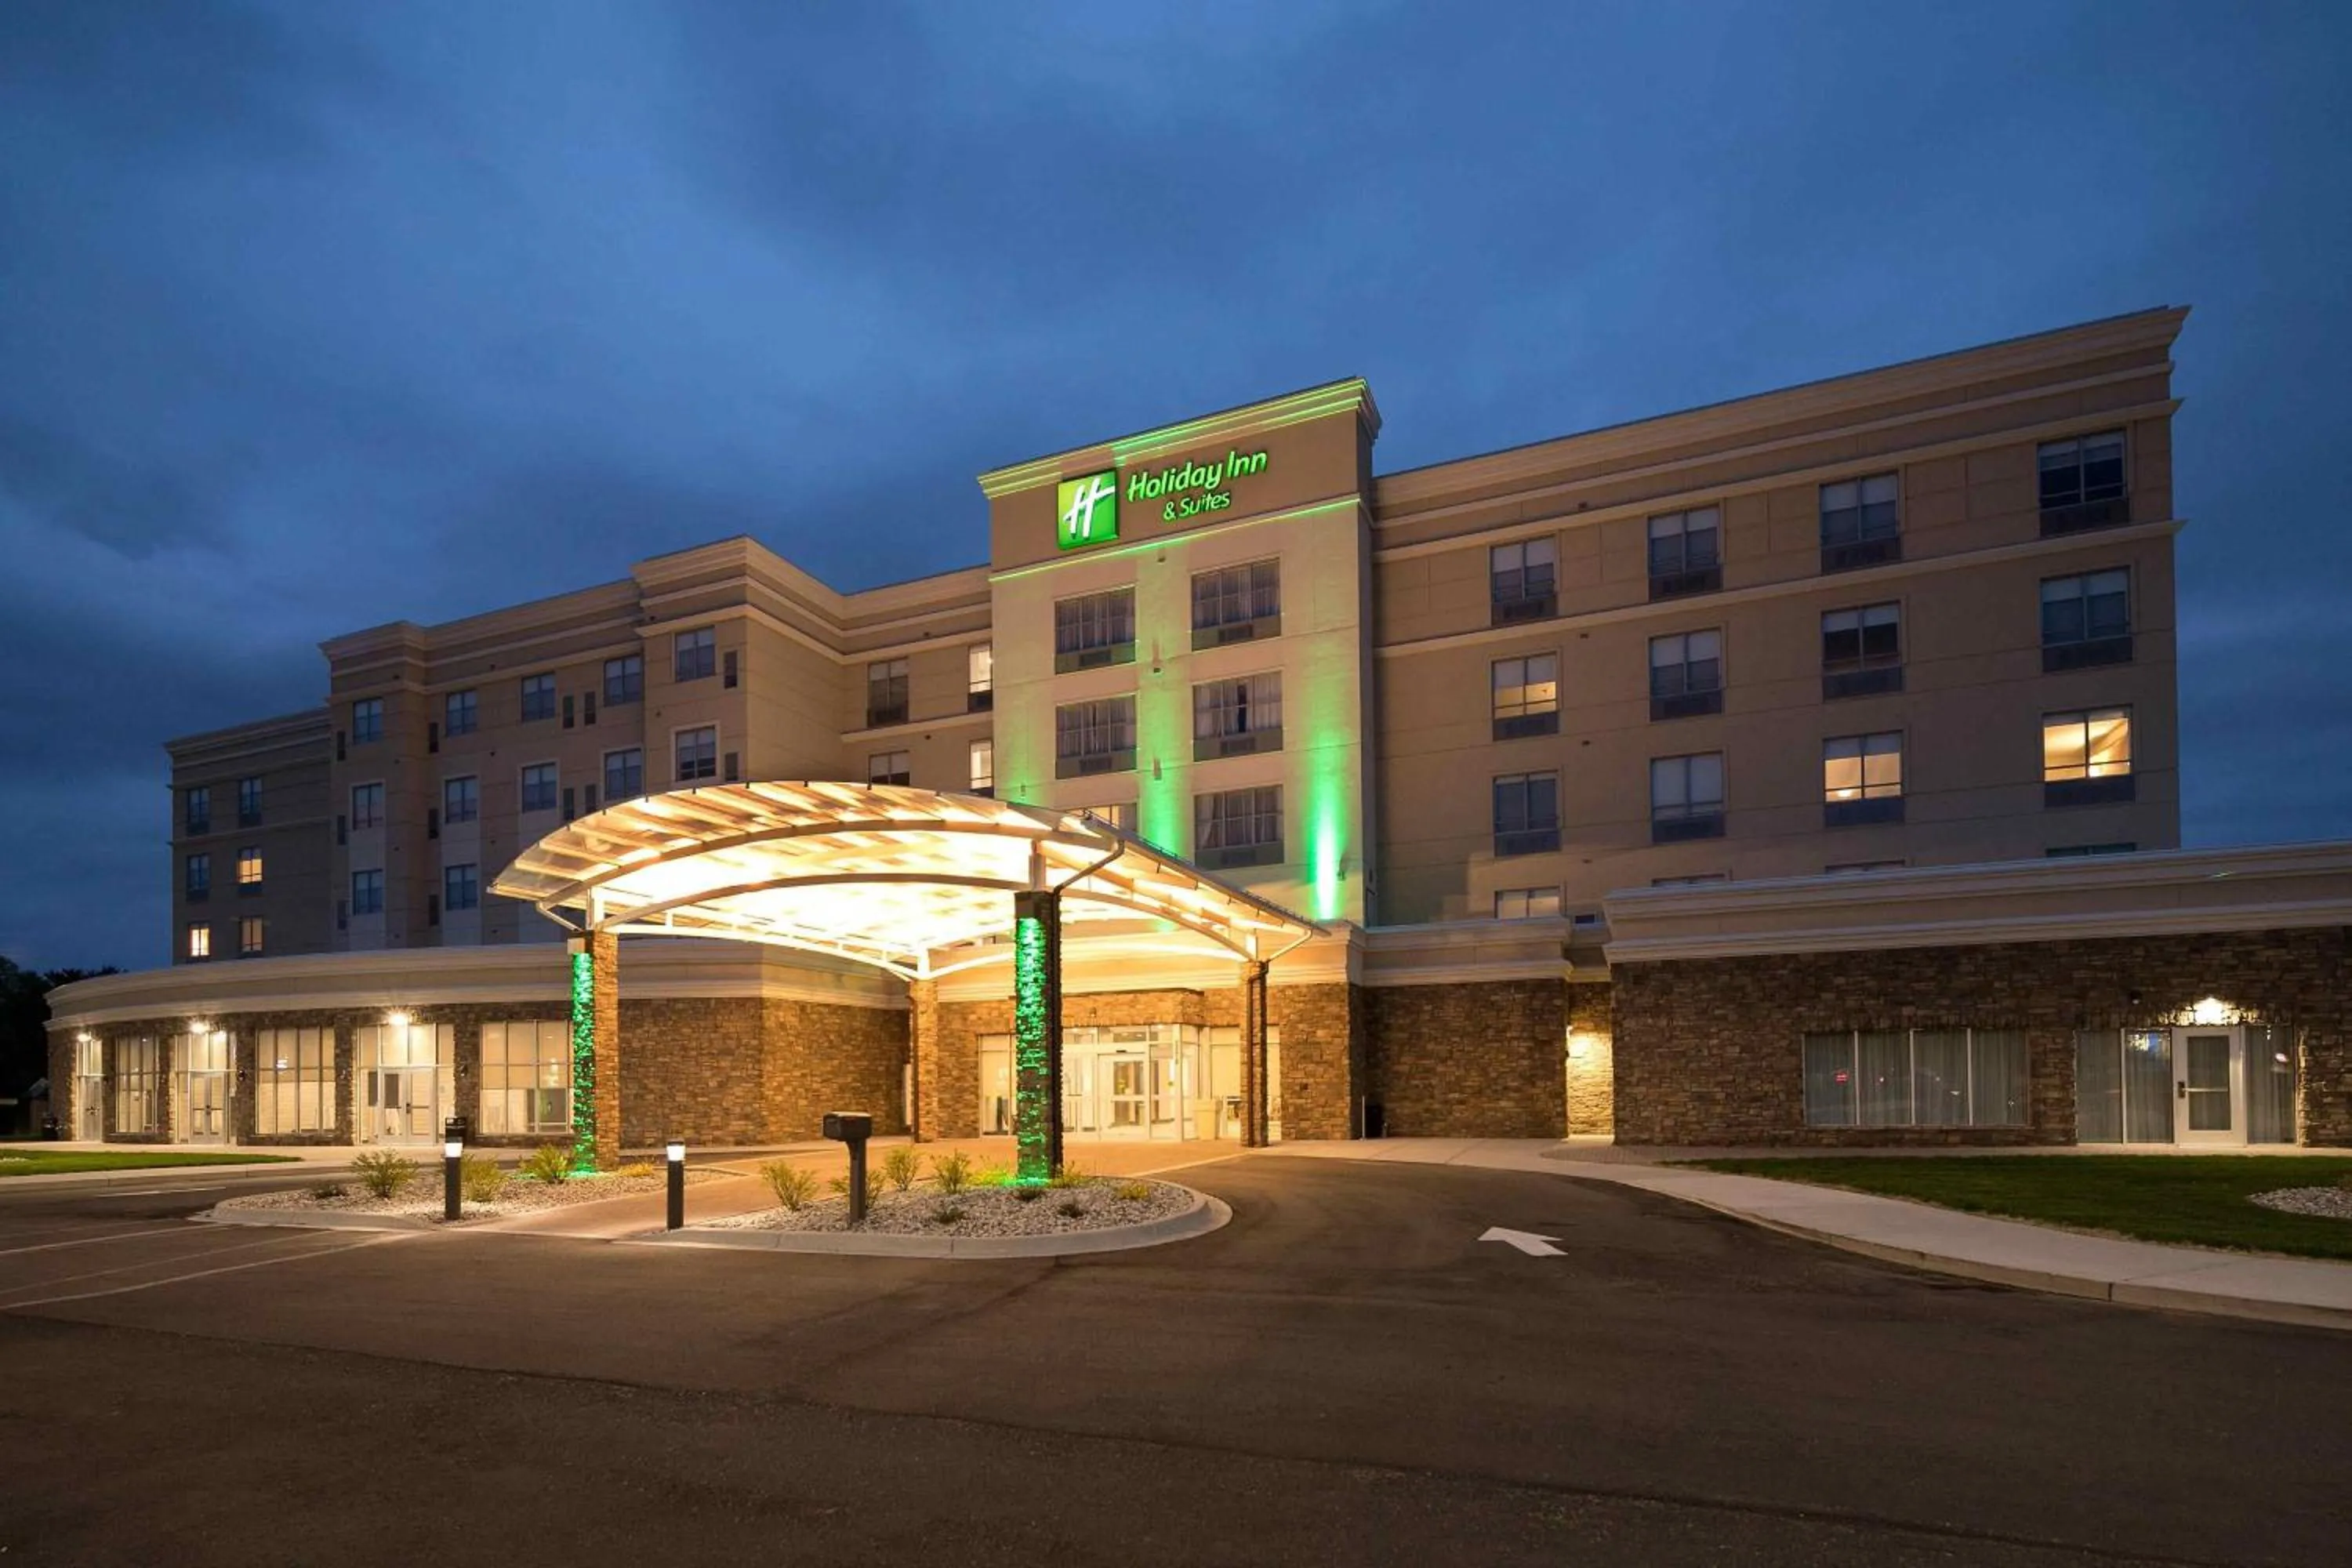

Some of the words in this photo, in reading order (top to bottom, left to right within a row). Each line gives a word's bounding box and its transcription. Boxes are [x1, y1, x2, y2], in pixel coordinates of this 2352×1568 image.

[1127, 462, 1221, 502] Holiday
[1226, 451, 1267, 477] Inn
[1163, 501, 1176, 521] &
[1179, 491, 1230, 517] Suites
